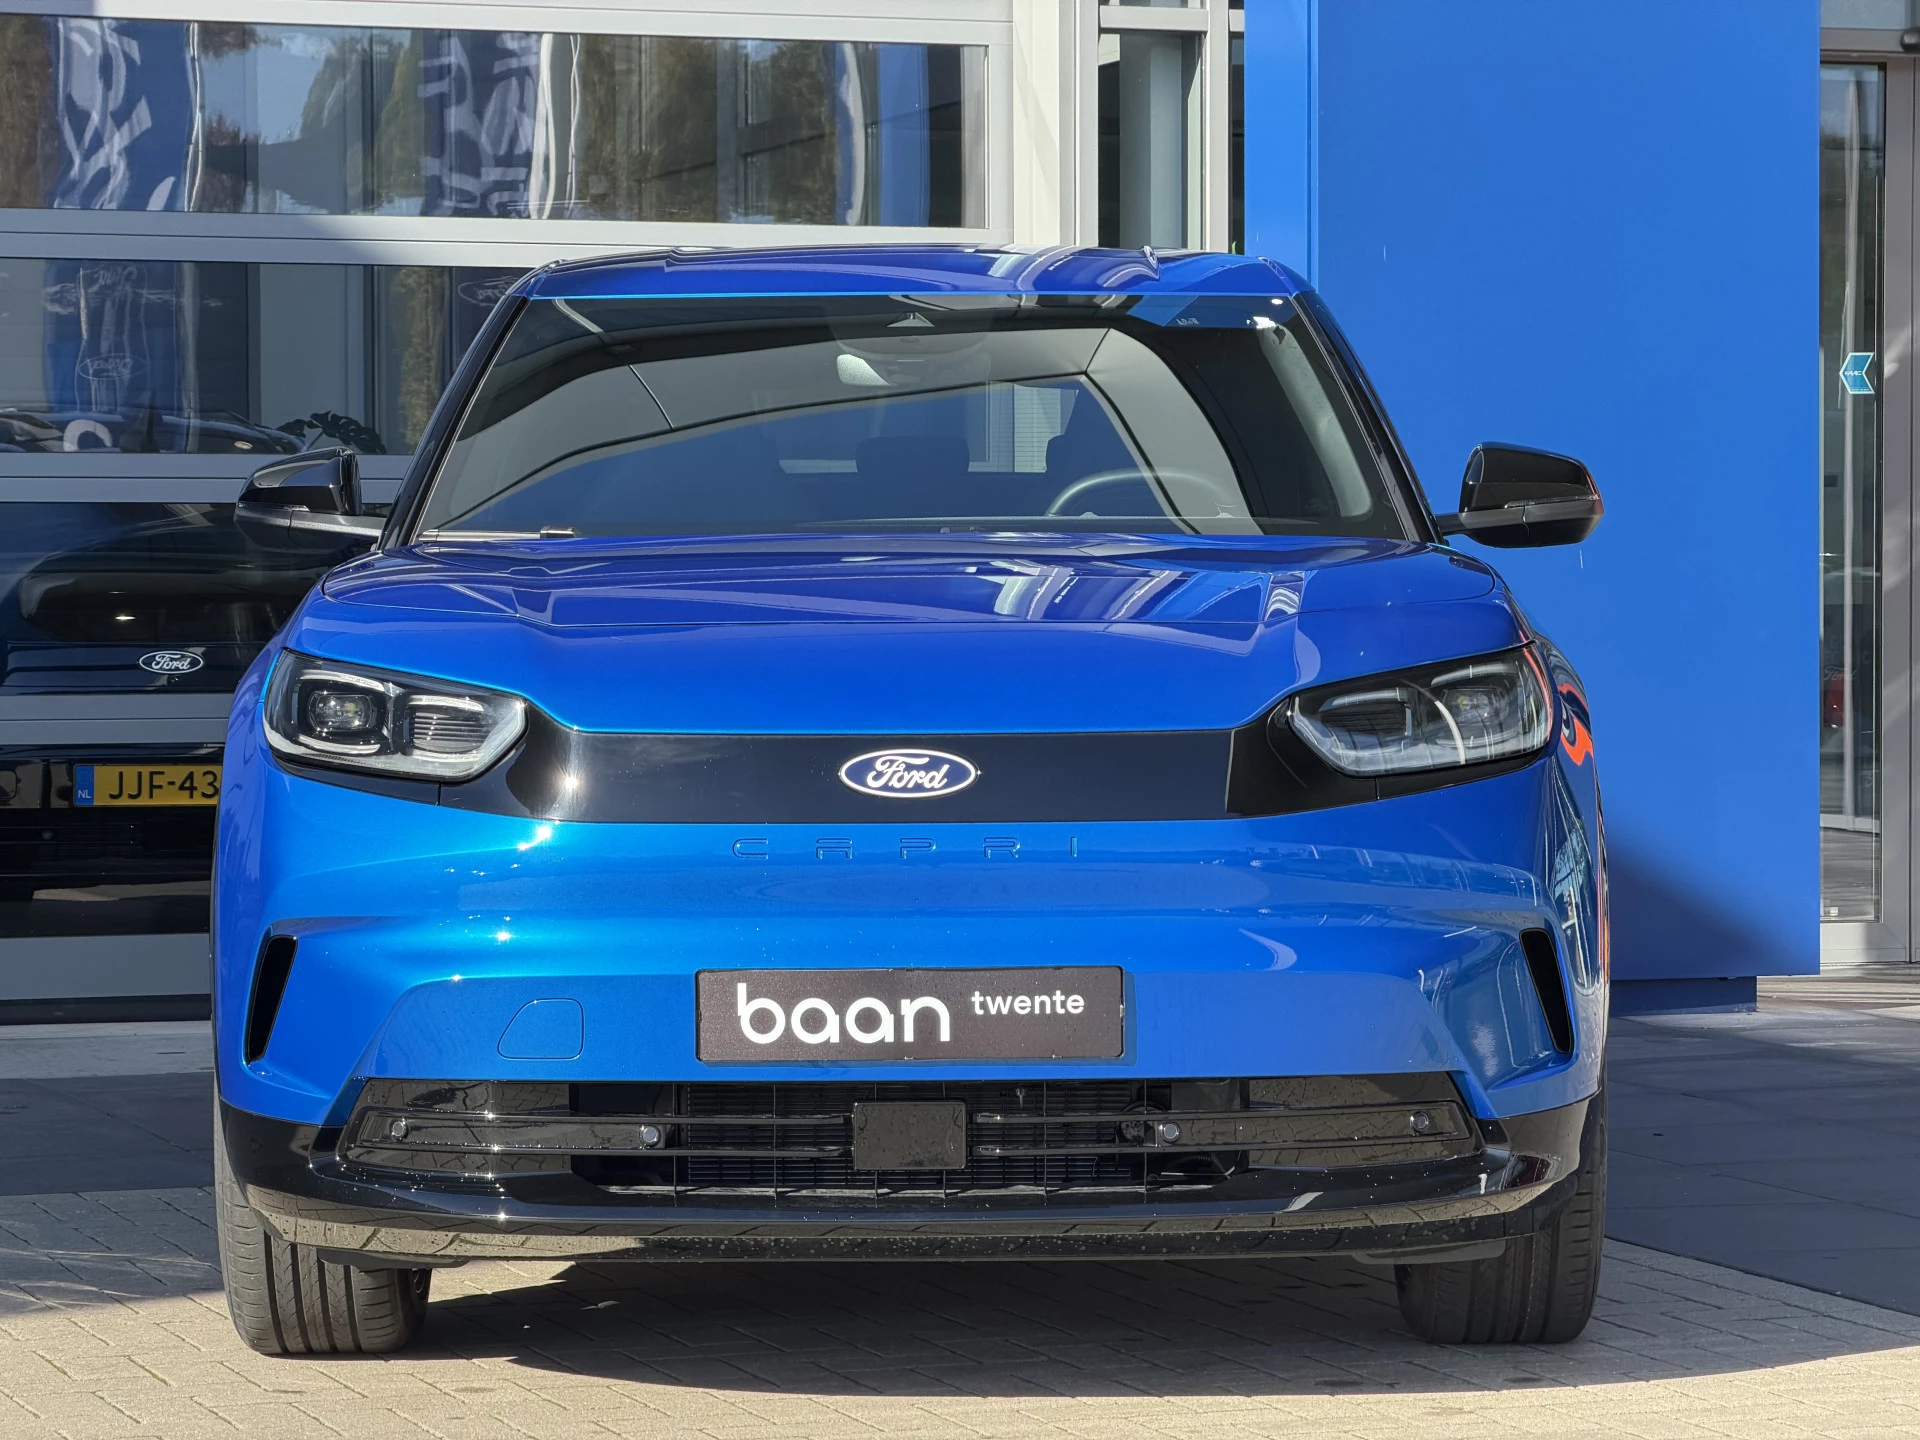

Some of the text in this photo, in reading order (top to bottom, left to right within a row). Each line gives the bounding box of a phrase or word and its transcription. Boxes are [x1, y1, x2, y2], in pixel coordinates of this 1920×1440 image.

[152, 653, 192, 670] Ford
[109, 770, 220, 800] JJF-43
[867, 755, 950, 789] Ford
[78, 790, 91, 799] NL
[732, 836, 1077, 860] CAPRI
[737, 982, 1085, 1044] baan twente
